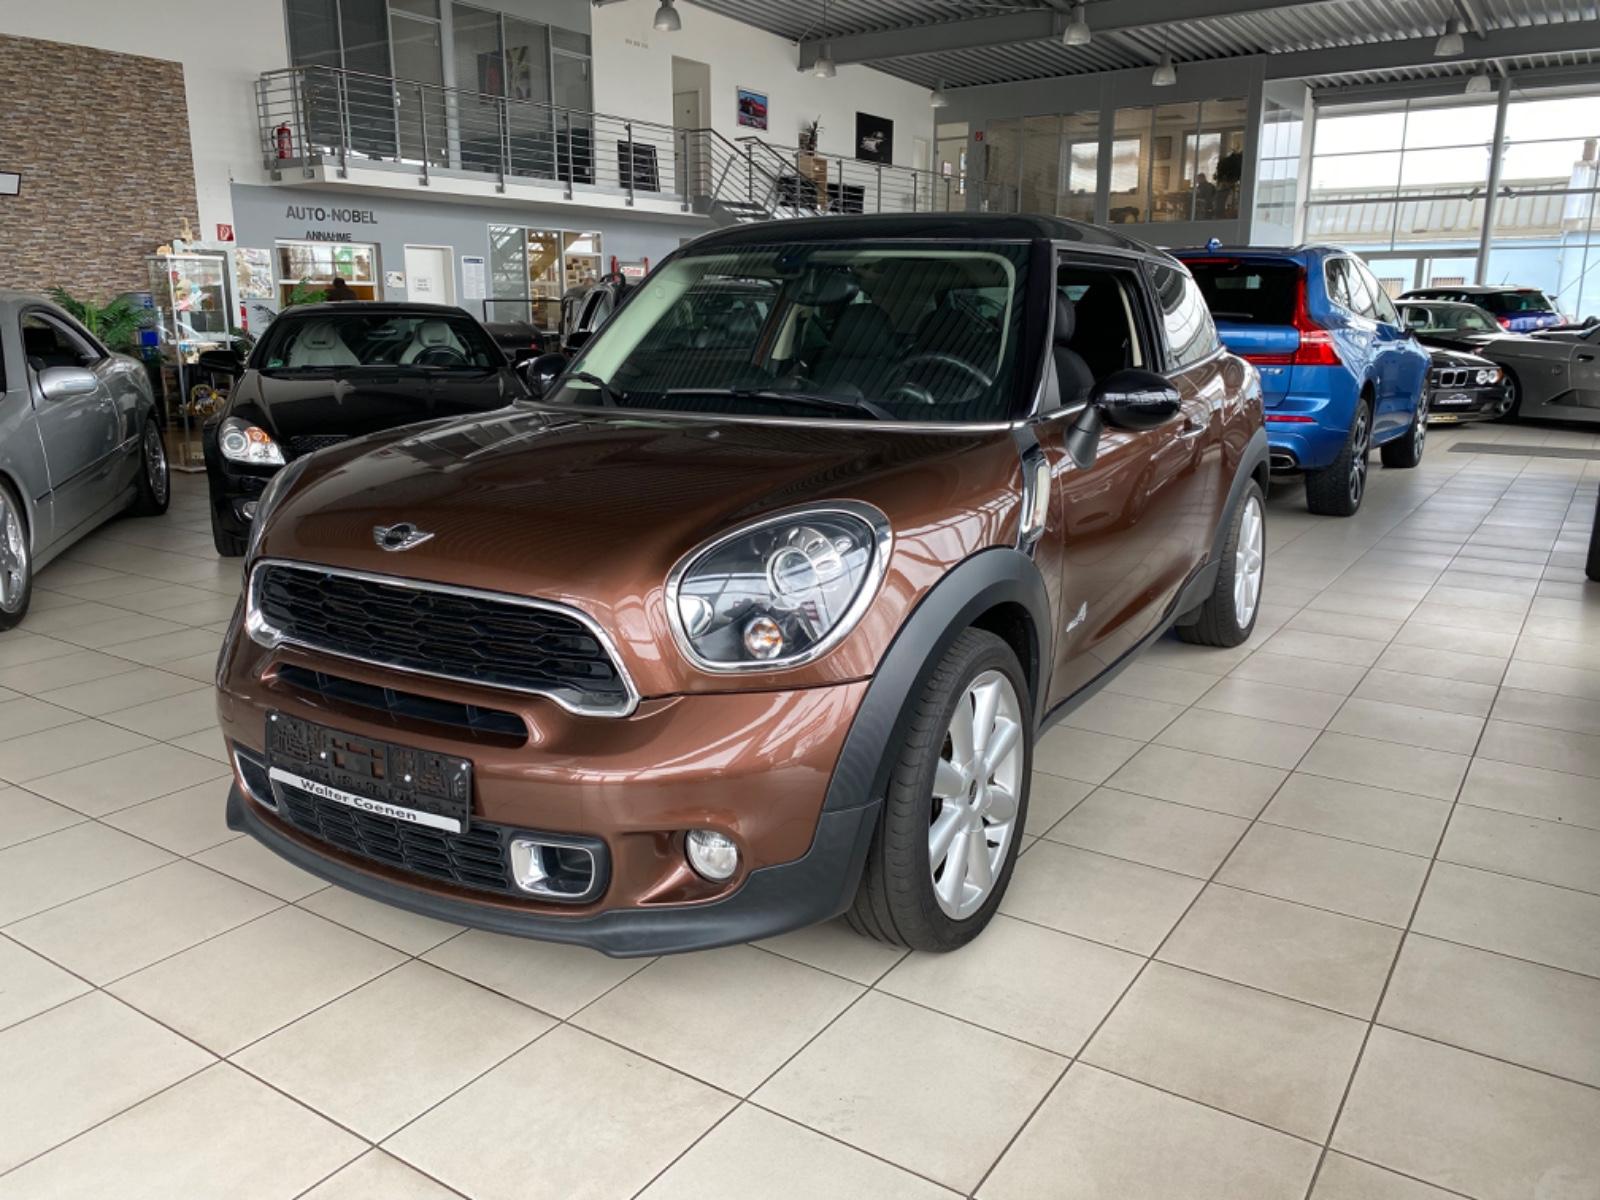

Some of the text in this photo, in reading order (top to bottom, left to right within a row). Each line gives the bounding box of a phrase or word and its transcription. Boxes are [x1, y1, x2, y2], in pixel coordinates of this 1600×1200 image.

[286, 205, 378, 224] AUTO-NOBEL
[306, 231, 352, 242] ANNAHME
[302, 779, 417, 821] Walter Coenen
